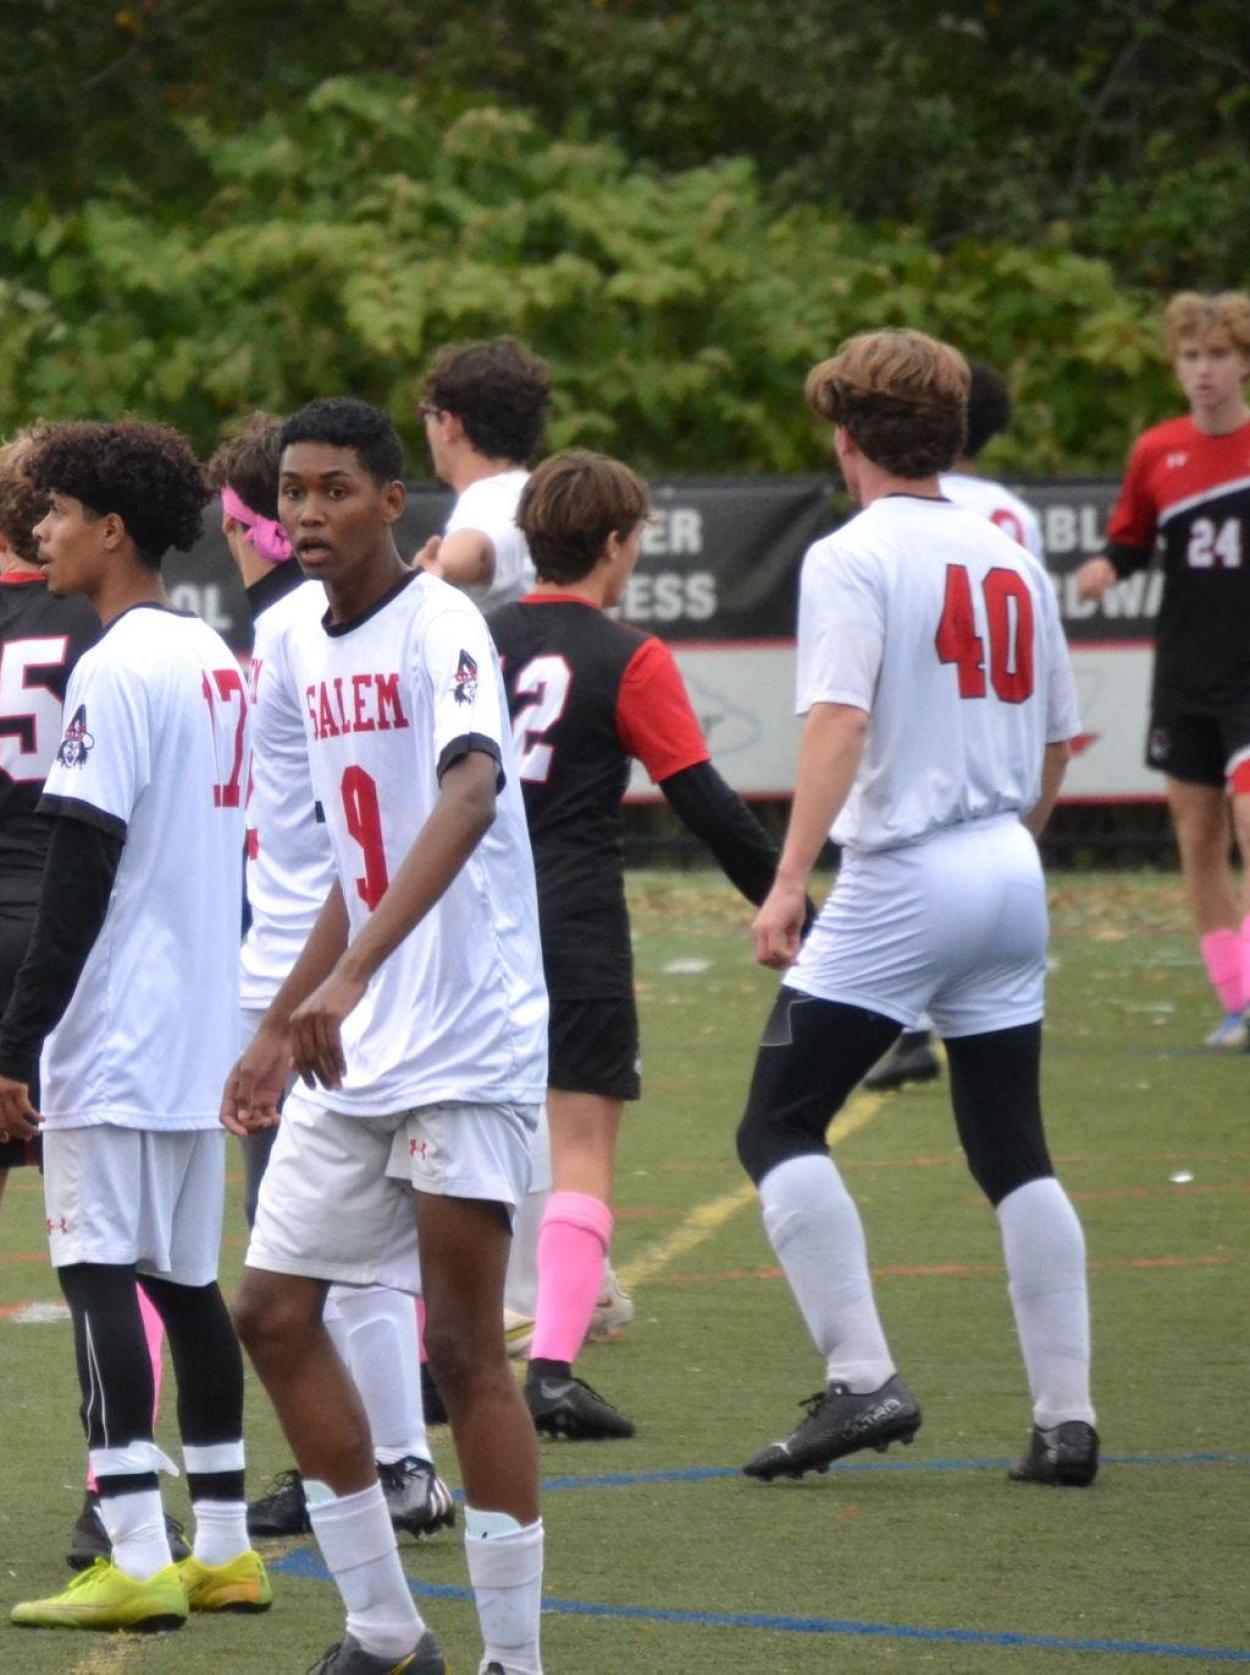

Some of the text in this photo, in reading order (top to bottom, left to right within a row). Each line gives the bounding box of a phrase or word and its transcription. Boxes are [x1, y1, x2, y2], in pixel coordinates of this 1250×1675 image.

[607, 573, 718, 620] ESS
[1187, 516, 1242, 569] 24
[935, 563, 1034, 704] 40
[202, 668, 248, 808] 17
[306, 672, 410, 742] SALEM
[500, 653, 574, 784] 2
[340, 764, 390, 912] 9
